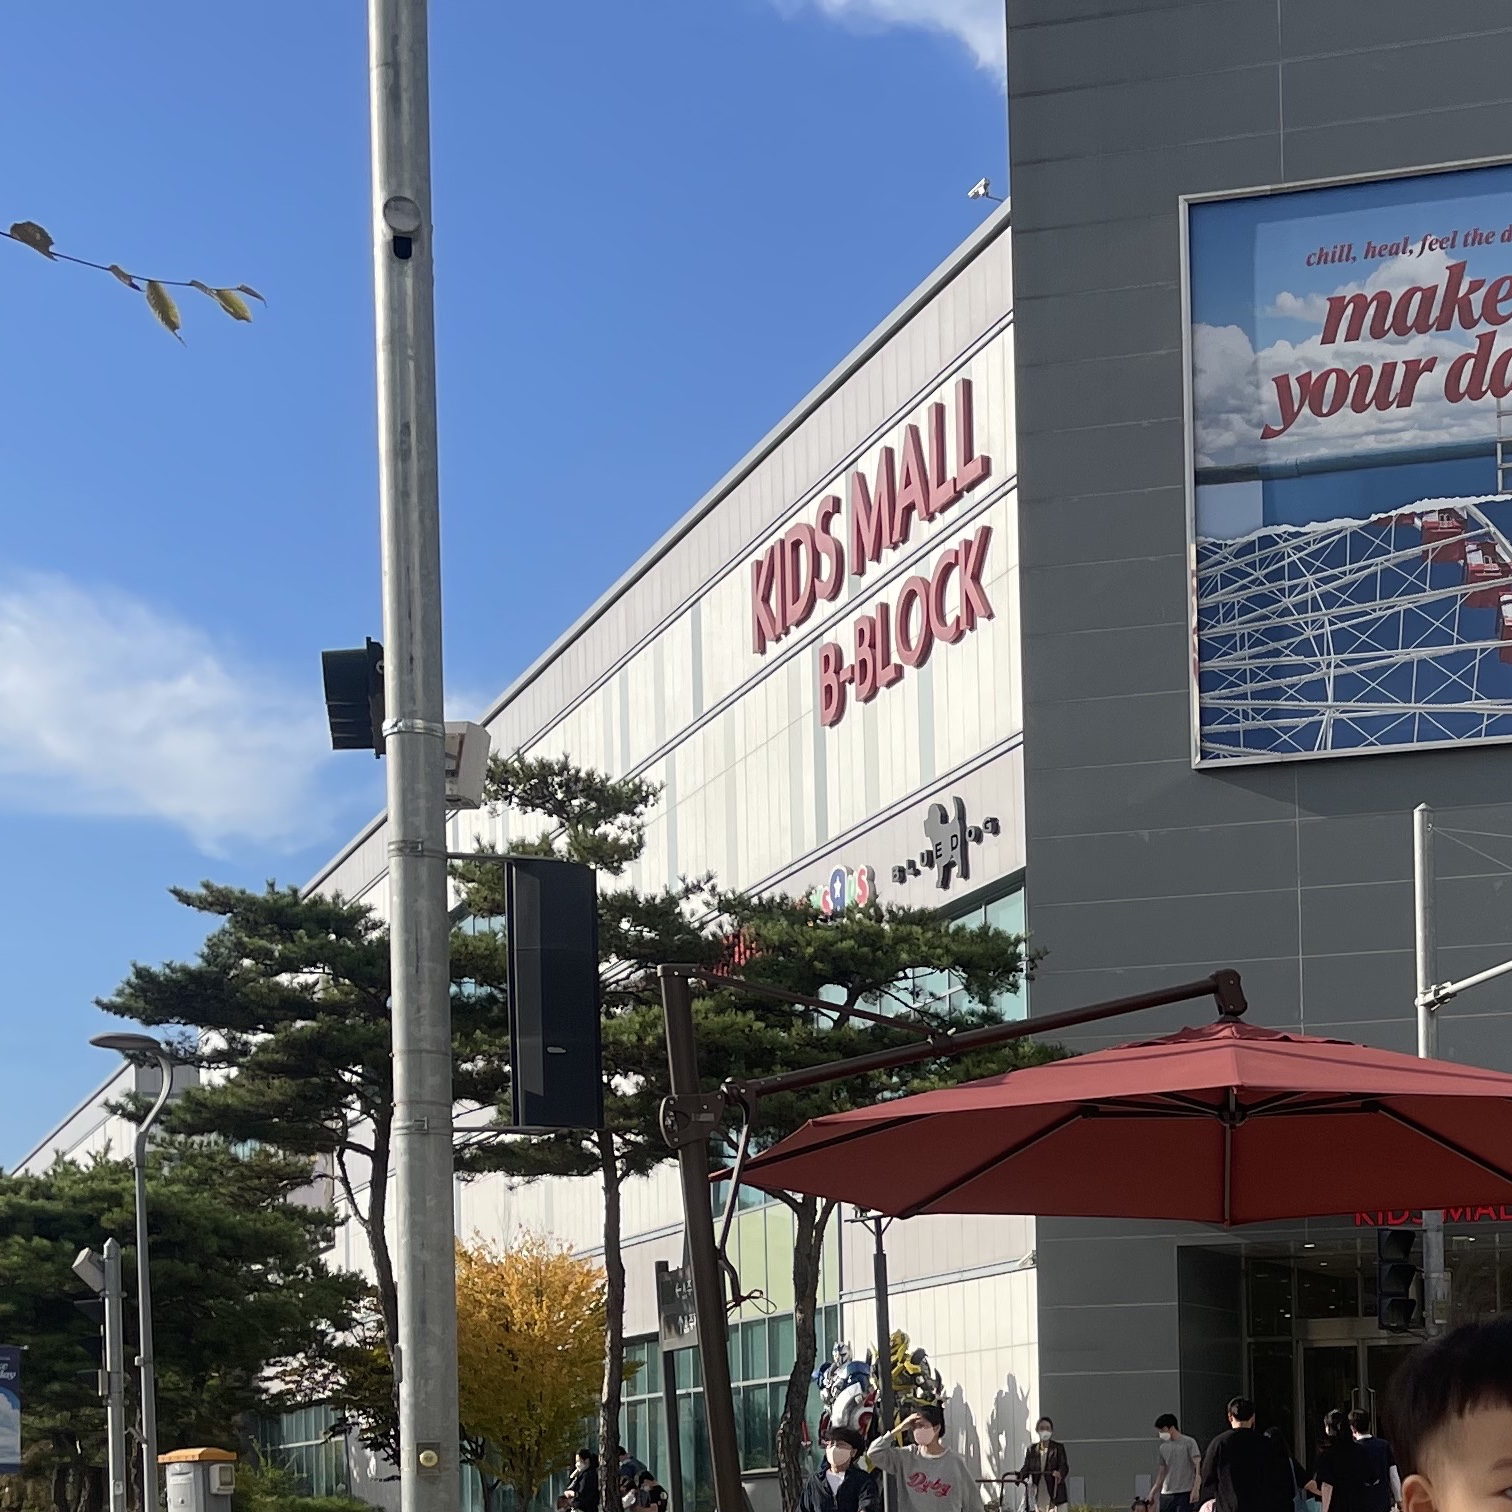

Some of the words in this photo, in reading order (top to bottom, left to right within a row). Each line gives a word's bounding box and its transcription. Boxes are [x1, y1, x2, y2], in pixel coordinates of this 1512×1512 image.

[1306, 242, 1357, 267] chill,
[1363, 235, 1413, 260] heal,
[1416, 229, 1459, 258] feel
[1463, 226, 1496, 248] the
[1260, 356, 1439, 440] your
[750, 494, 846, 656] KIDS
[850, 377, 993, 577] MALL
[818, 524, 996, 729] B-BLOCK
